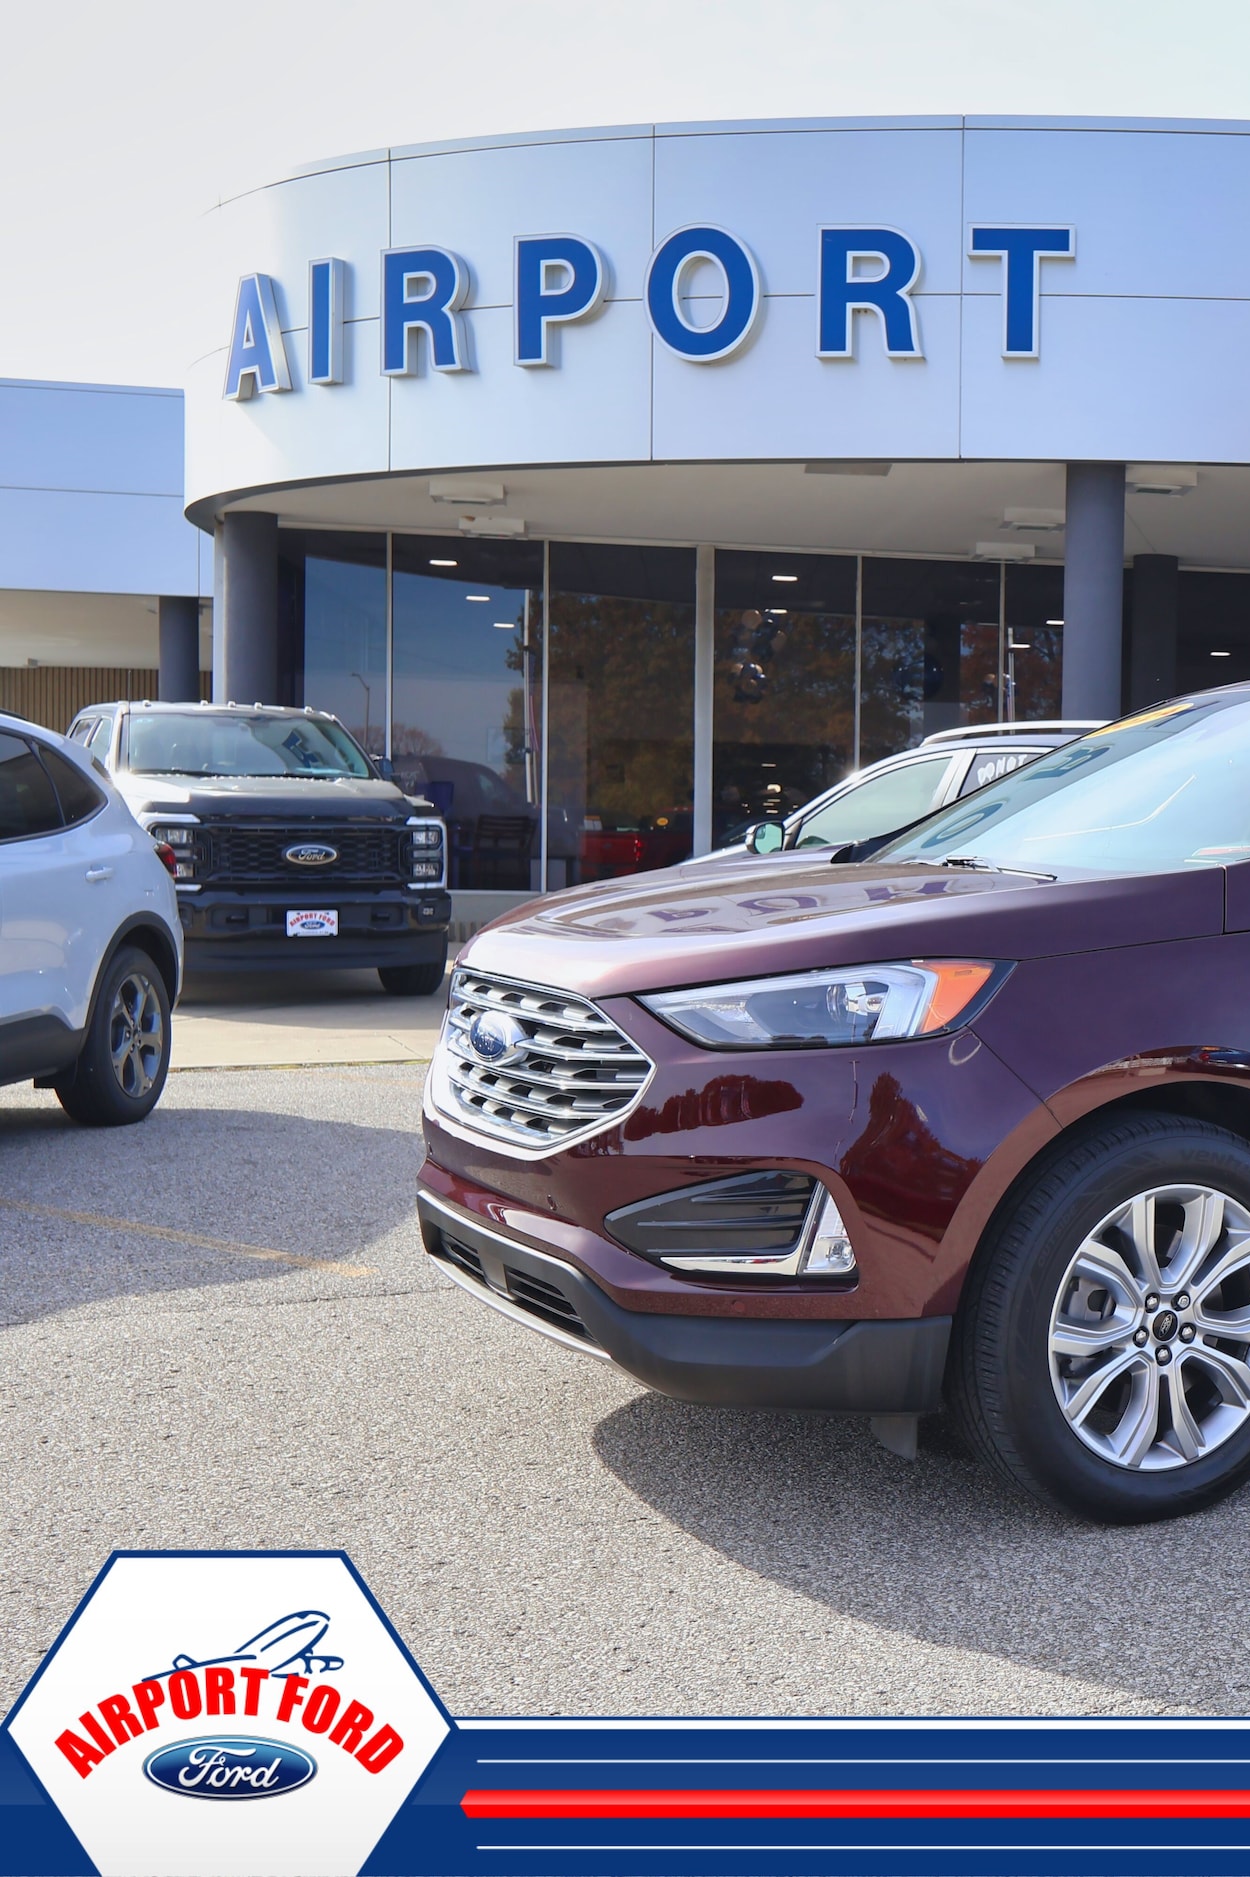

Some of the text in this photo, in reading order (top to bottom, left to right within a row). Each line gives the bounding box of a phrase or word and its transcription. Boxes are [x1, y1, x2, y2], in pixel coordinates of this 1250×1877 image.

[221, 222, 1077, 402] AIRPORT
[298, 847, 326, 861] Ford
[289, 912, 336, 927] AIRPORT FORD
[304, 920, 321, 929] Ford
